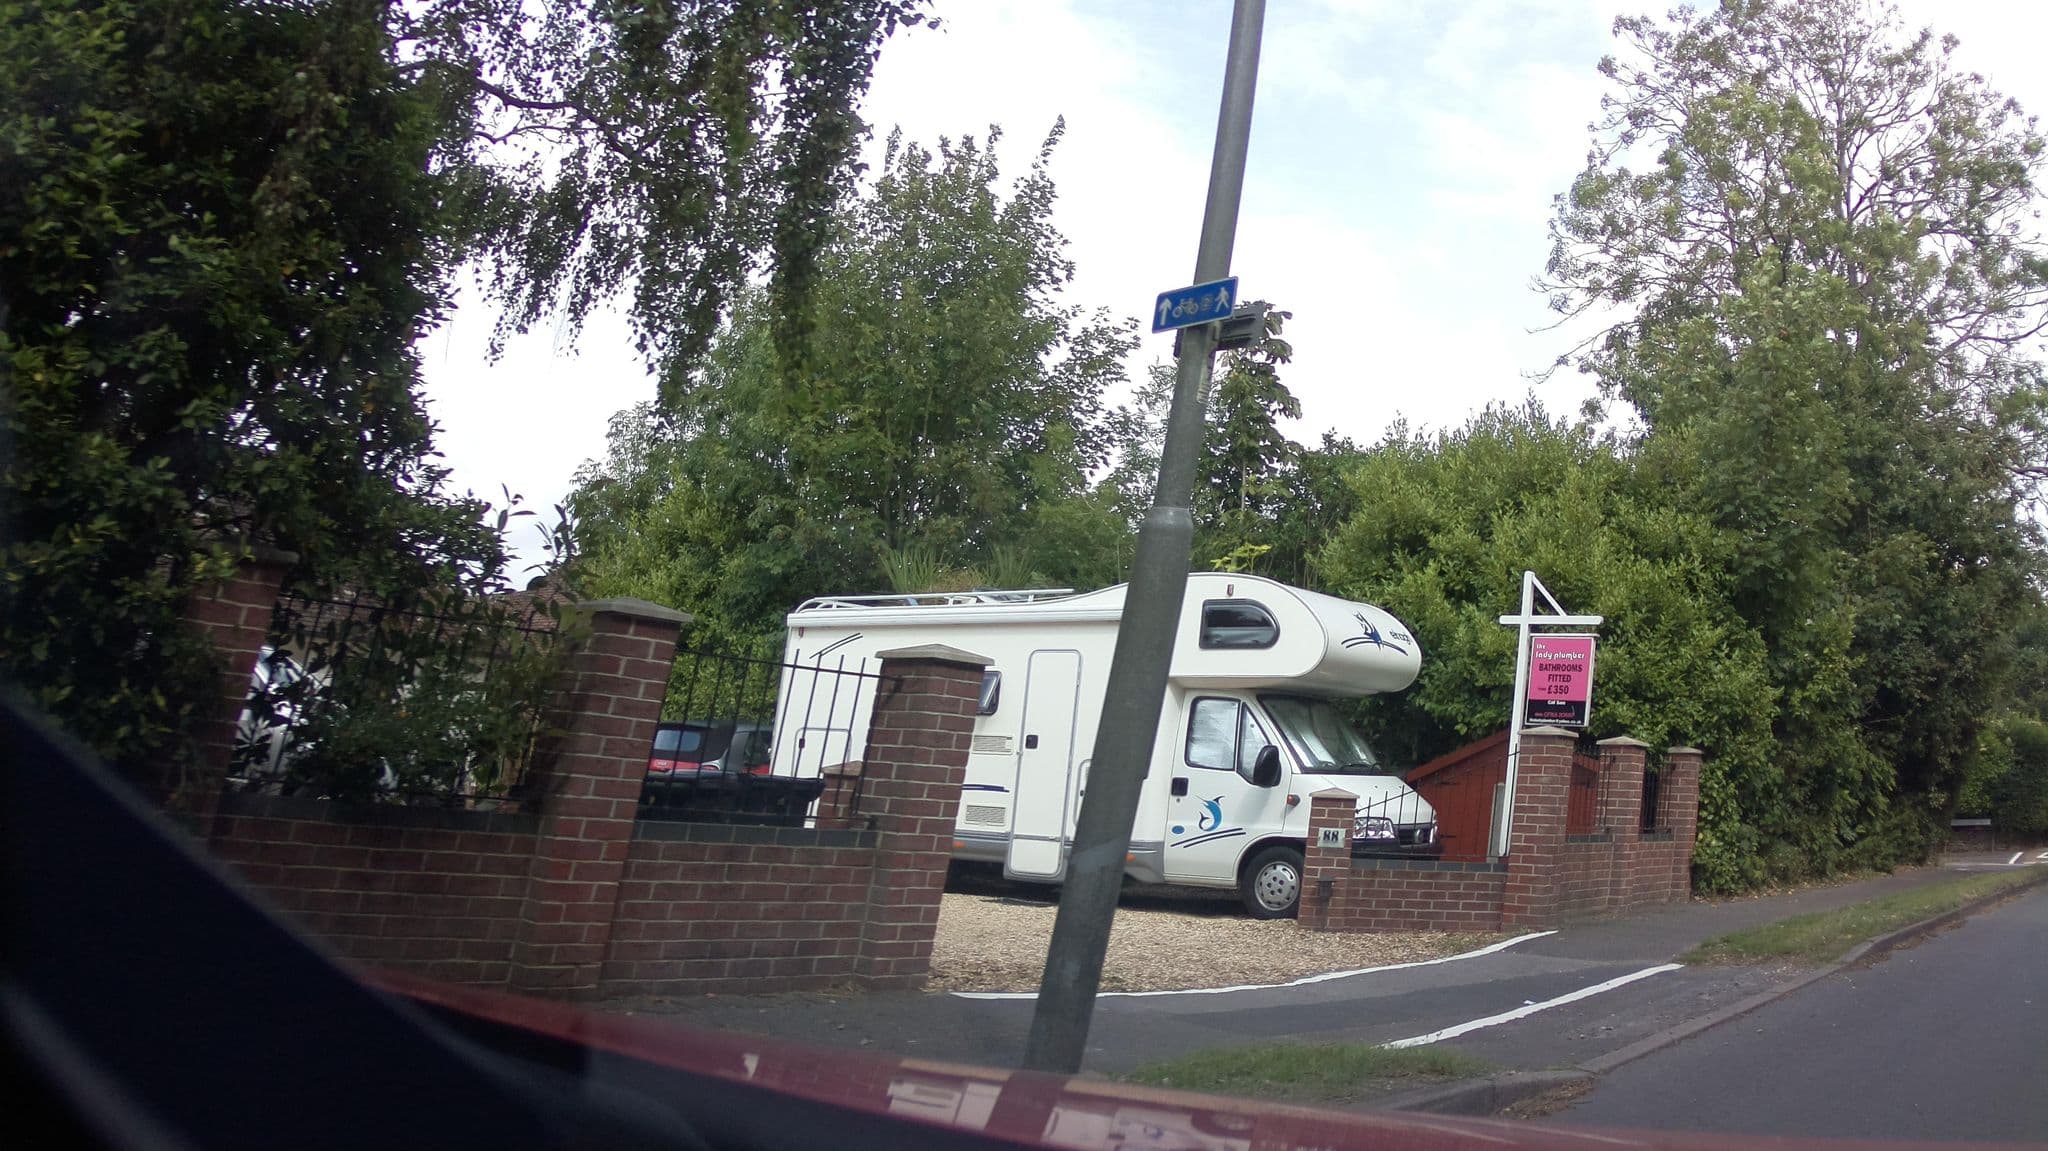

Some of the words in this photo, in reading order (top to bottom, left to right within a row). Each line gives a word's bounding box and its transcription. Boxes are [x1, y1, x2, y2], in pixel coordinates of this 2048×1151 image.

[1553, 651, 1585, 660] plumber
[1538, 663, 1583, 672] BATHROOMS
[1547, 674, 1572, 683] FITTED
[1547, 685, 1569, 695] £350
